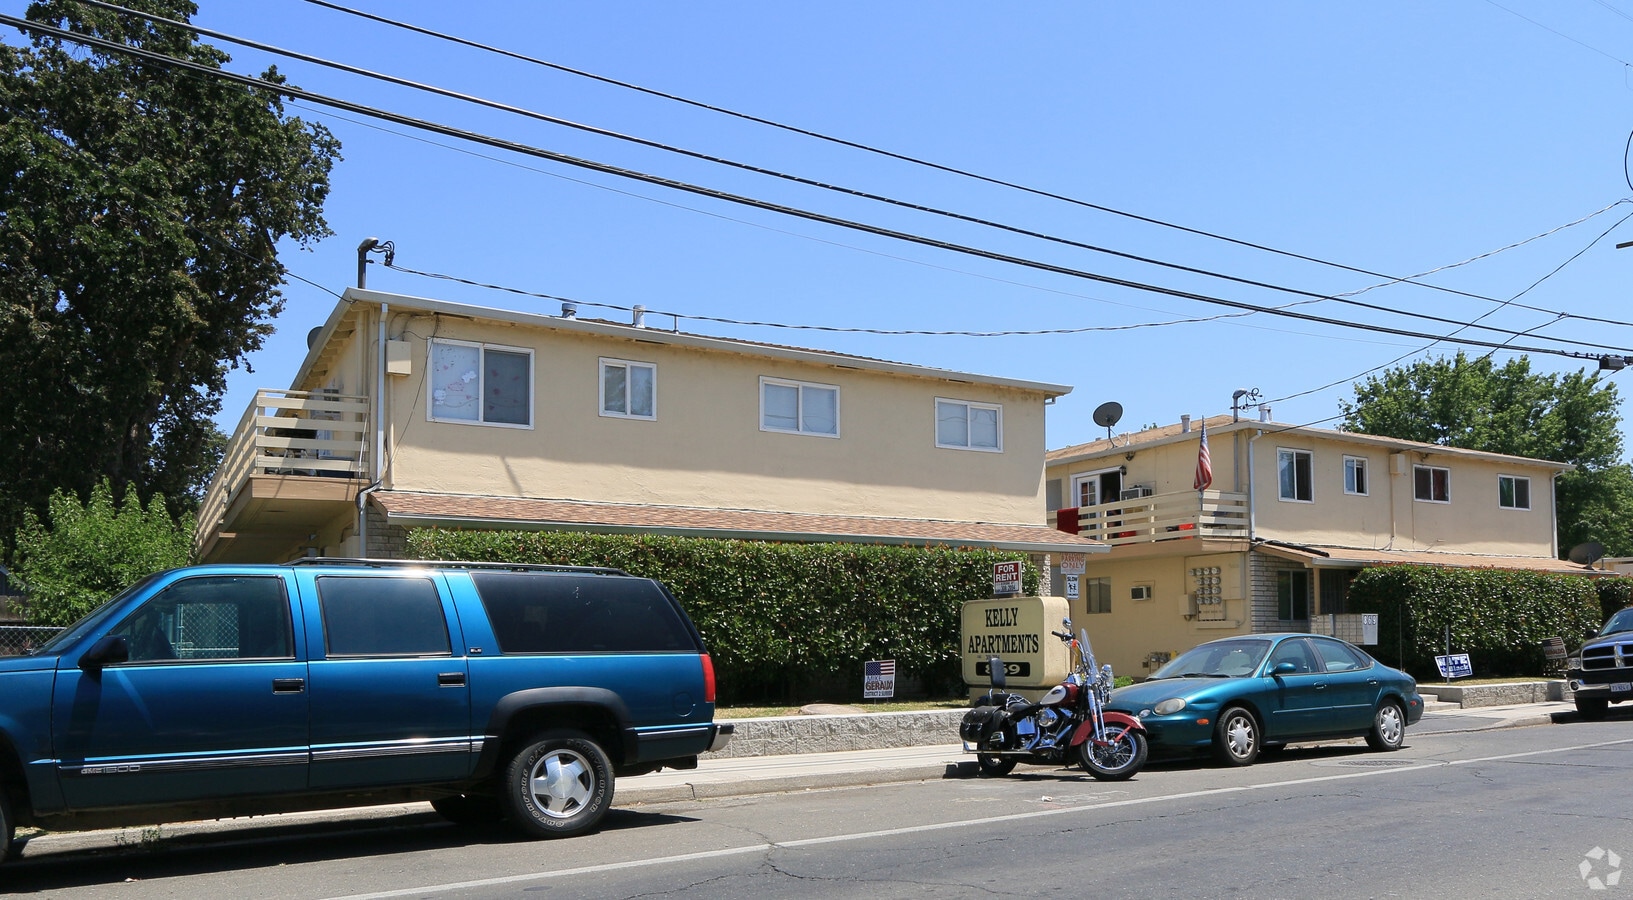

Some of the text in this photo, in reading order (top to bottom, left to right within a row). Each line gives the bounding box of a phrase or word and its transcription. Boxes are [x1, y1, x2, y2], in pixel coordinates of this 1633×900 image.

[997, 564, 1015, 573] FOR
[995, 572, 1018, 582] RENT
[985, 607, 1018, 627] KELLY
[968, 634, 1039, 653] APARTMENTS
